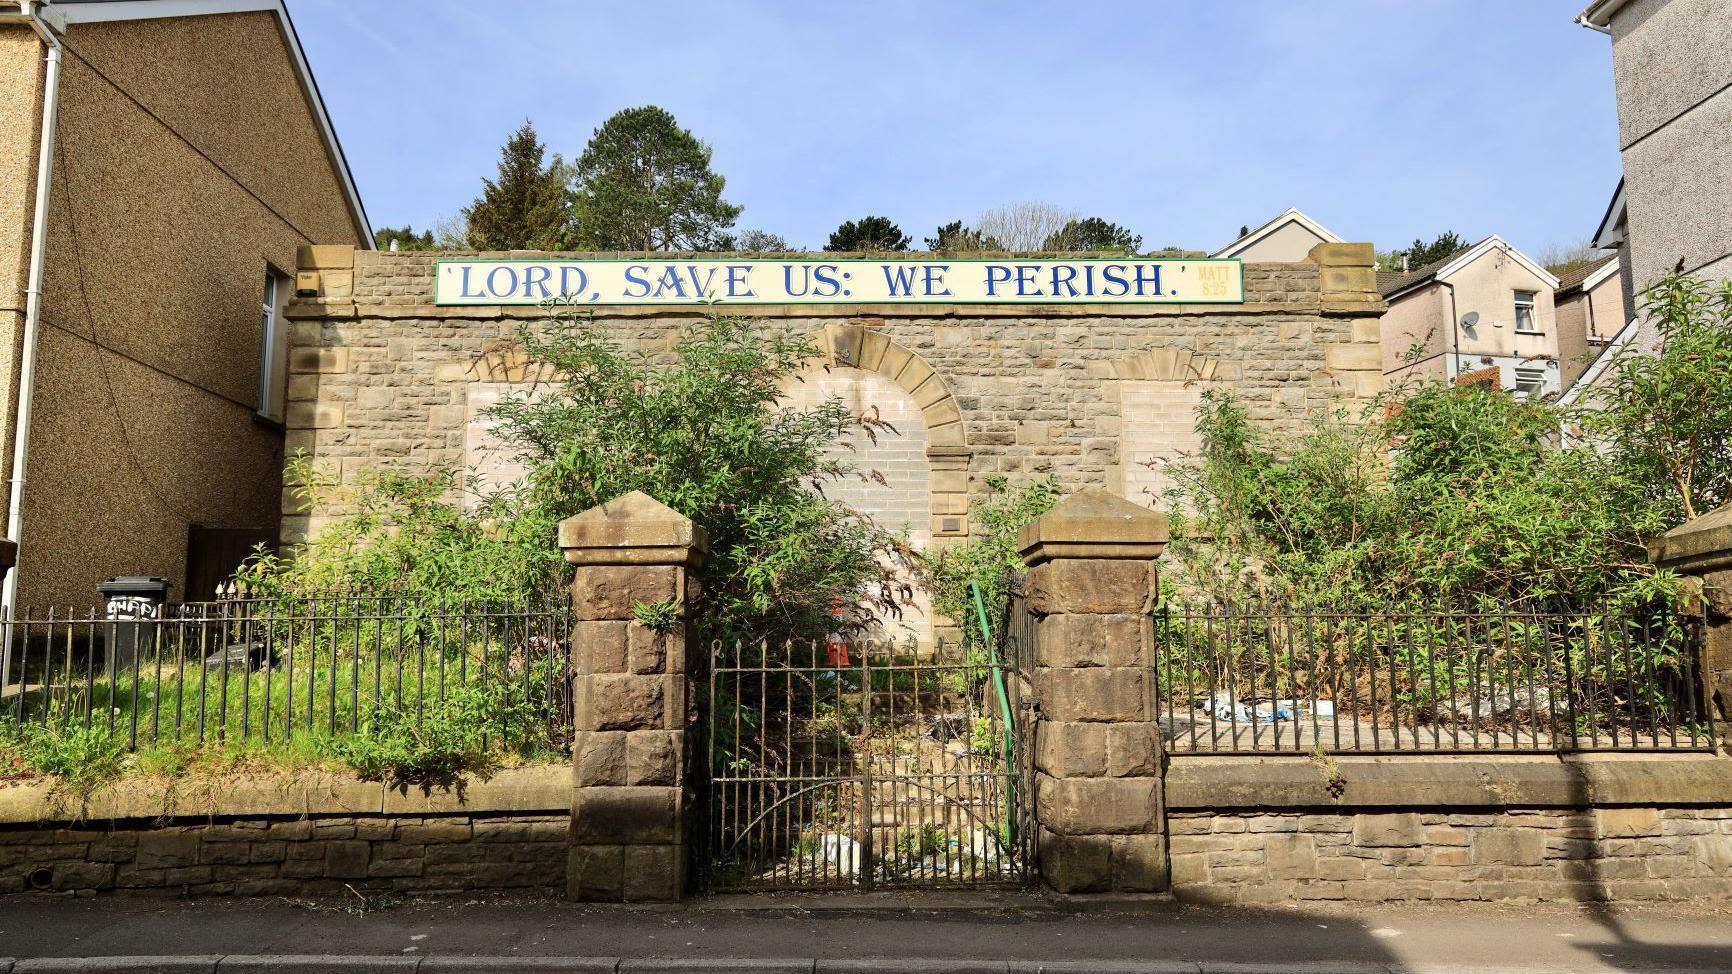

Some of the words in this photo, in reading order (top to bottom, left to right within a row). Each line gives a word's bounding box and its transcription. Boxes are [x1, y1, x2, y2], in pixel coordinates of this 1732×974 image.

[624, 265, 756, 299] SAVE
[784, 265, 853, 298] US:
[881, 264, 952, 298] WE
[1198, 265, 1232, 281] MATT
